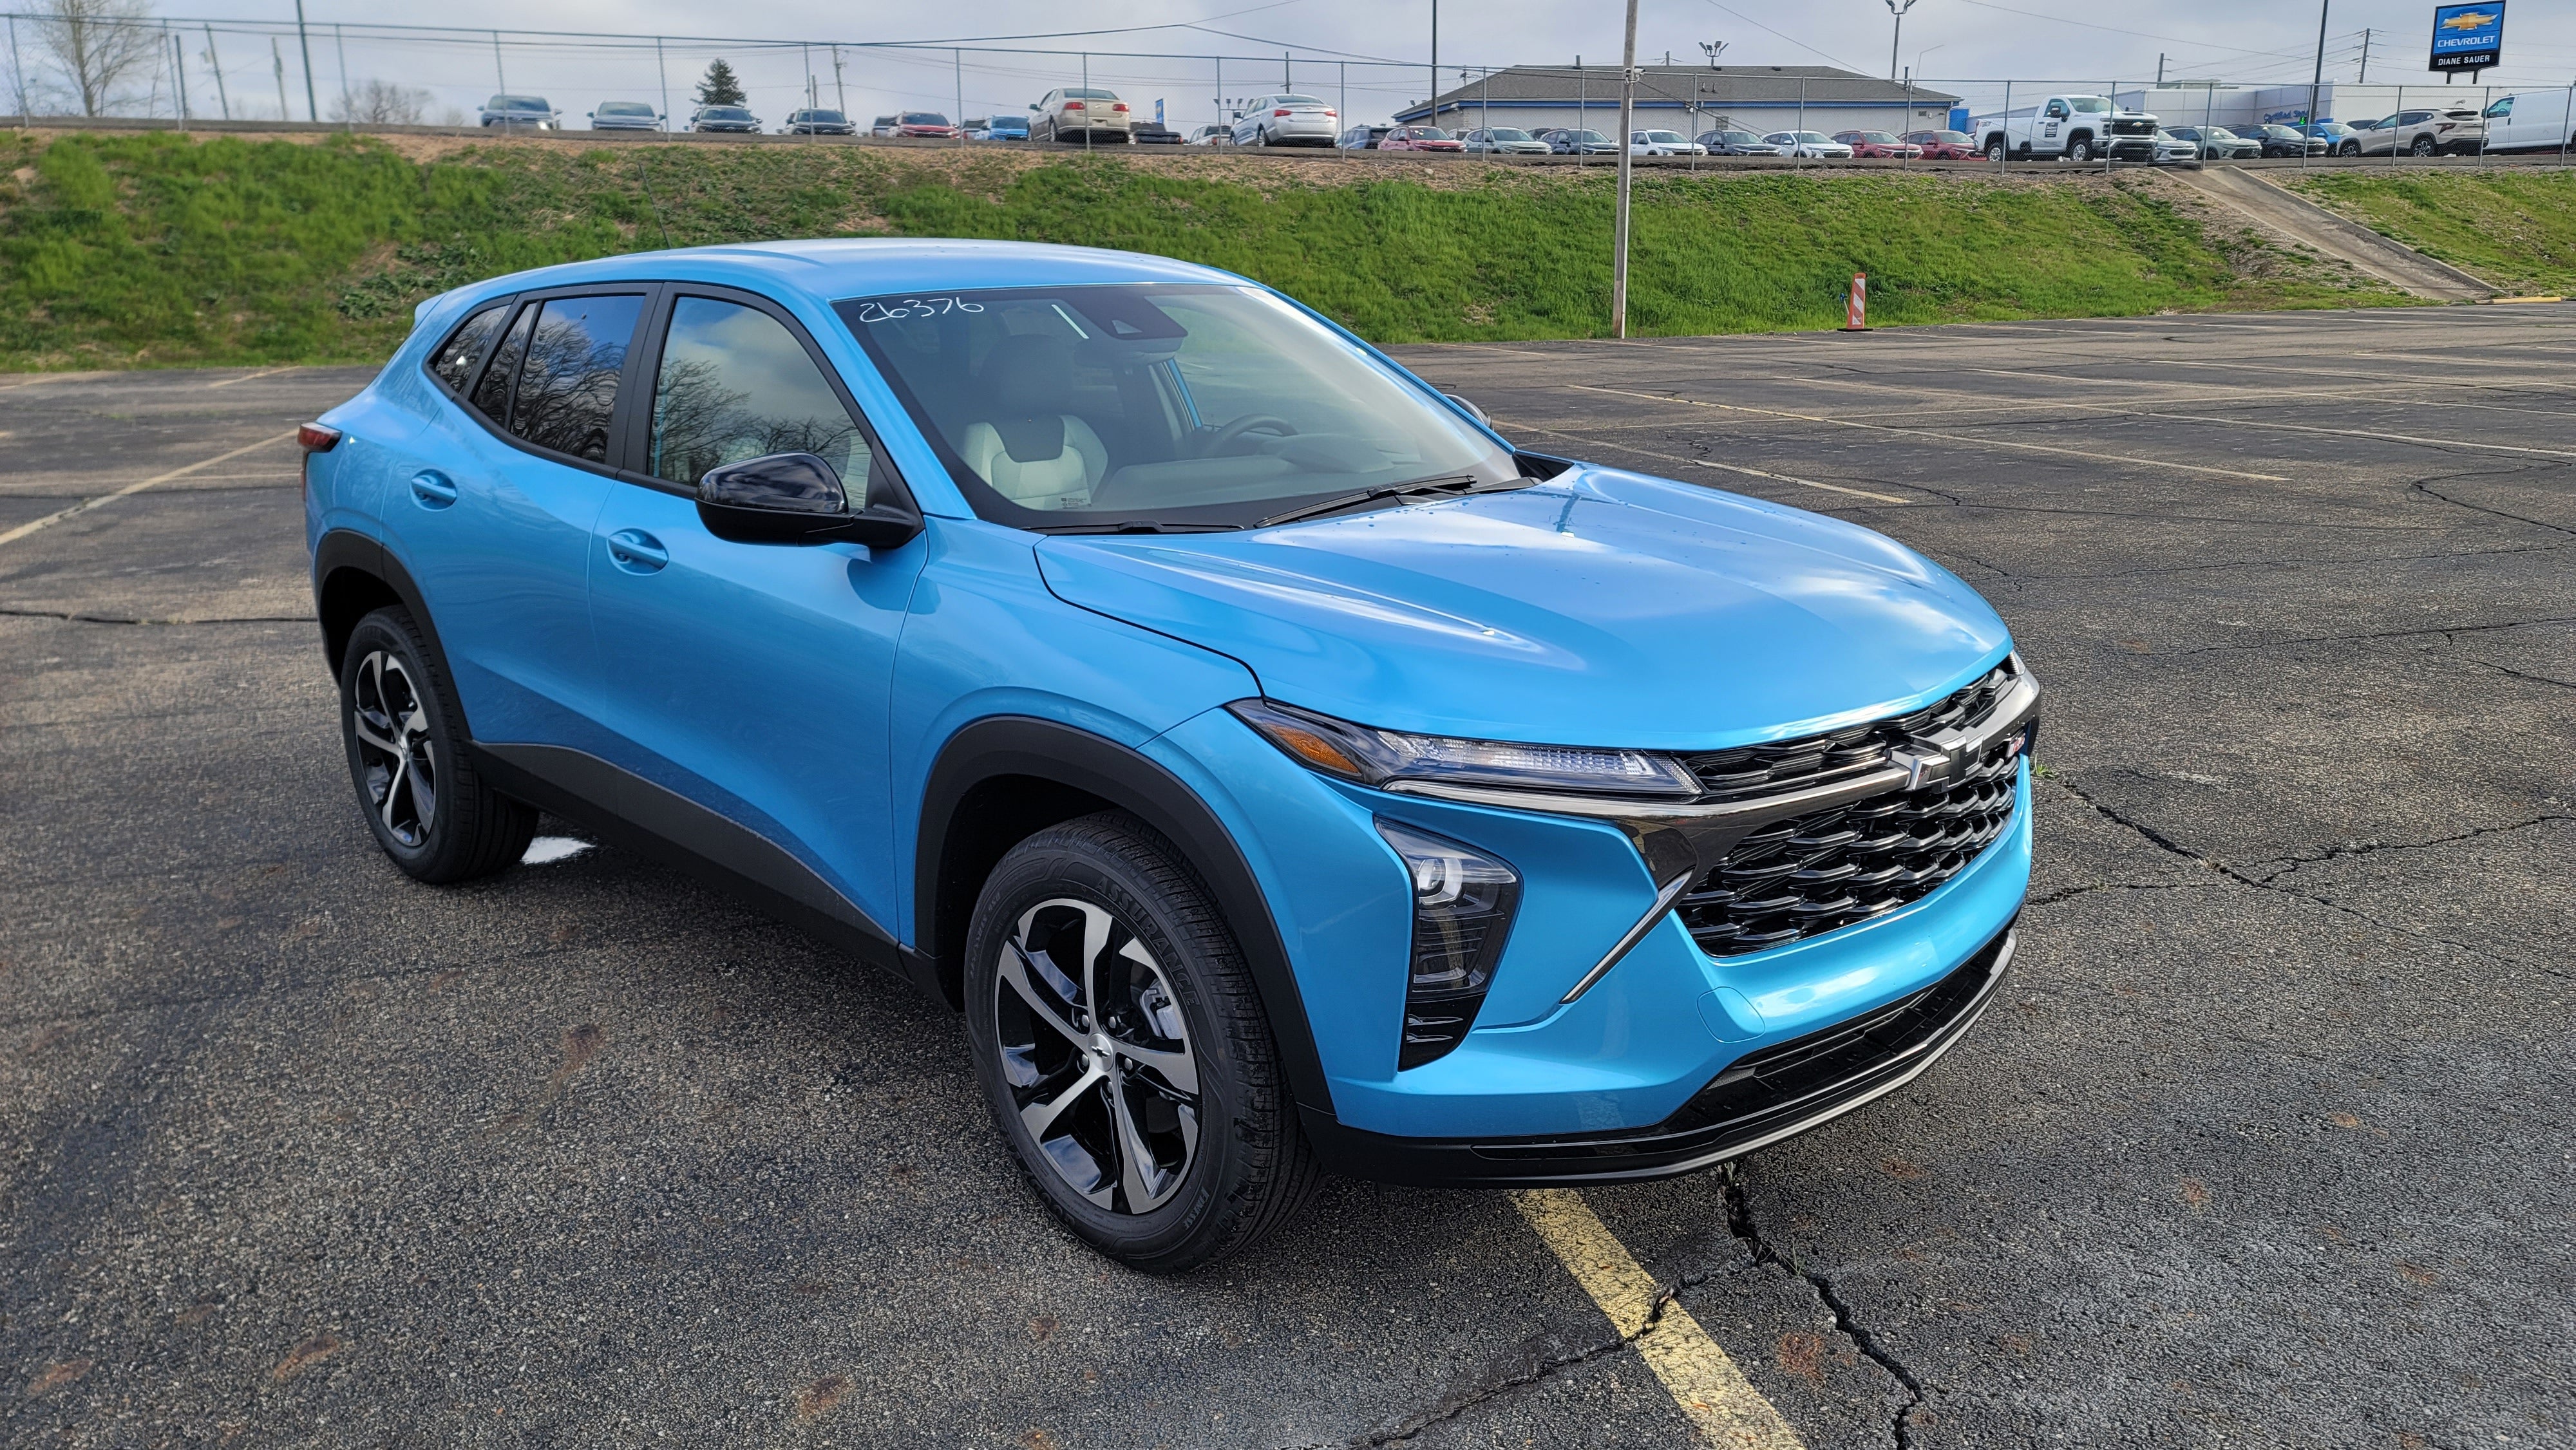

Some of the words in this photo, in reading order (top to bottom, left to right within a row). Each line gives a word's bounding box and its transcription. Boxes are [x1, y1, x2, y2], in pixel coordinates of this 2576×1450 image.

[2438, 35, 2496, 48] CHEVROLET
[2438, 57, 2461, 66] DIANE
[2463, 55, 2490, 64] SAUER
[859, 296, 985, 323] 26376
[1095, 876, 1200, 1006] ASSURANCE
